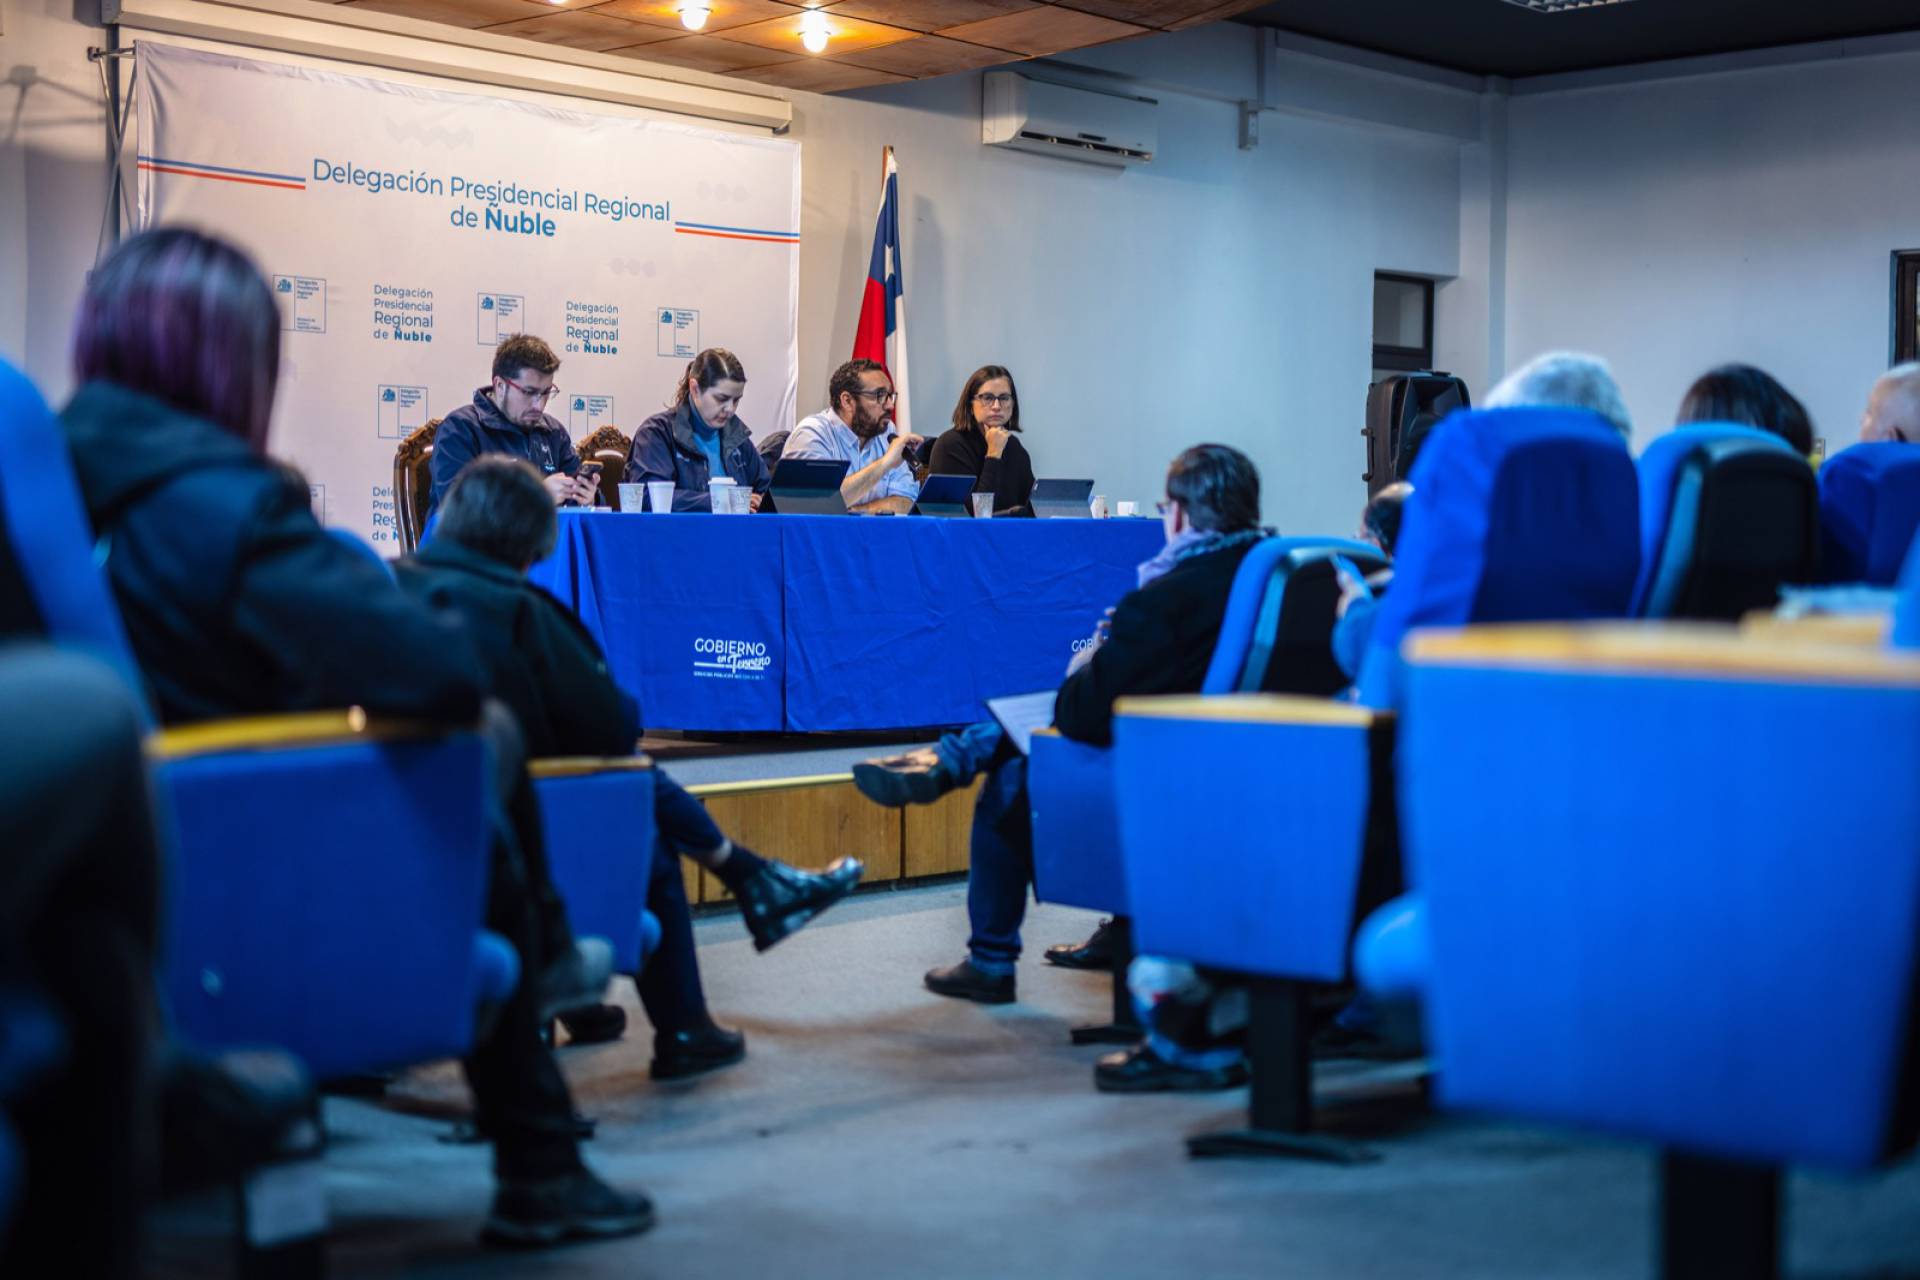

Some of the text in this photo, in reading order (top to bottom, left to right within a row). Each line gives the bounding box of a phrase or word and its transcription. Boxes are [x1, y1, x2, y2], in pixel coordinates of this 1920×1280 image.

[313, 158, 670, 221] Delegación Presidencial Regional
[450, 202, 556, 236] de Ñuble
[374, 284, 433, 299] Delegación
[374, 298, 433, 312] Presidencial
[566, 301, 619, 314] Delegación
[374, 311, 433, 328] Regional
[566, 313, 619, 326] Presidencial
[373, 328, 432, 342] de Ñuble
[566, 326, 619, 342] Regional
[565, 341, 618, 355] de Ñuble
[371, 531, 387, 541] de
[694, 638, 766, 656] GOBIERNO
